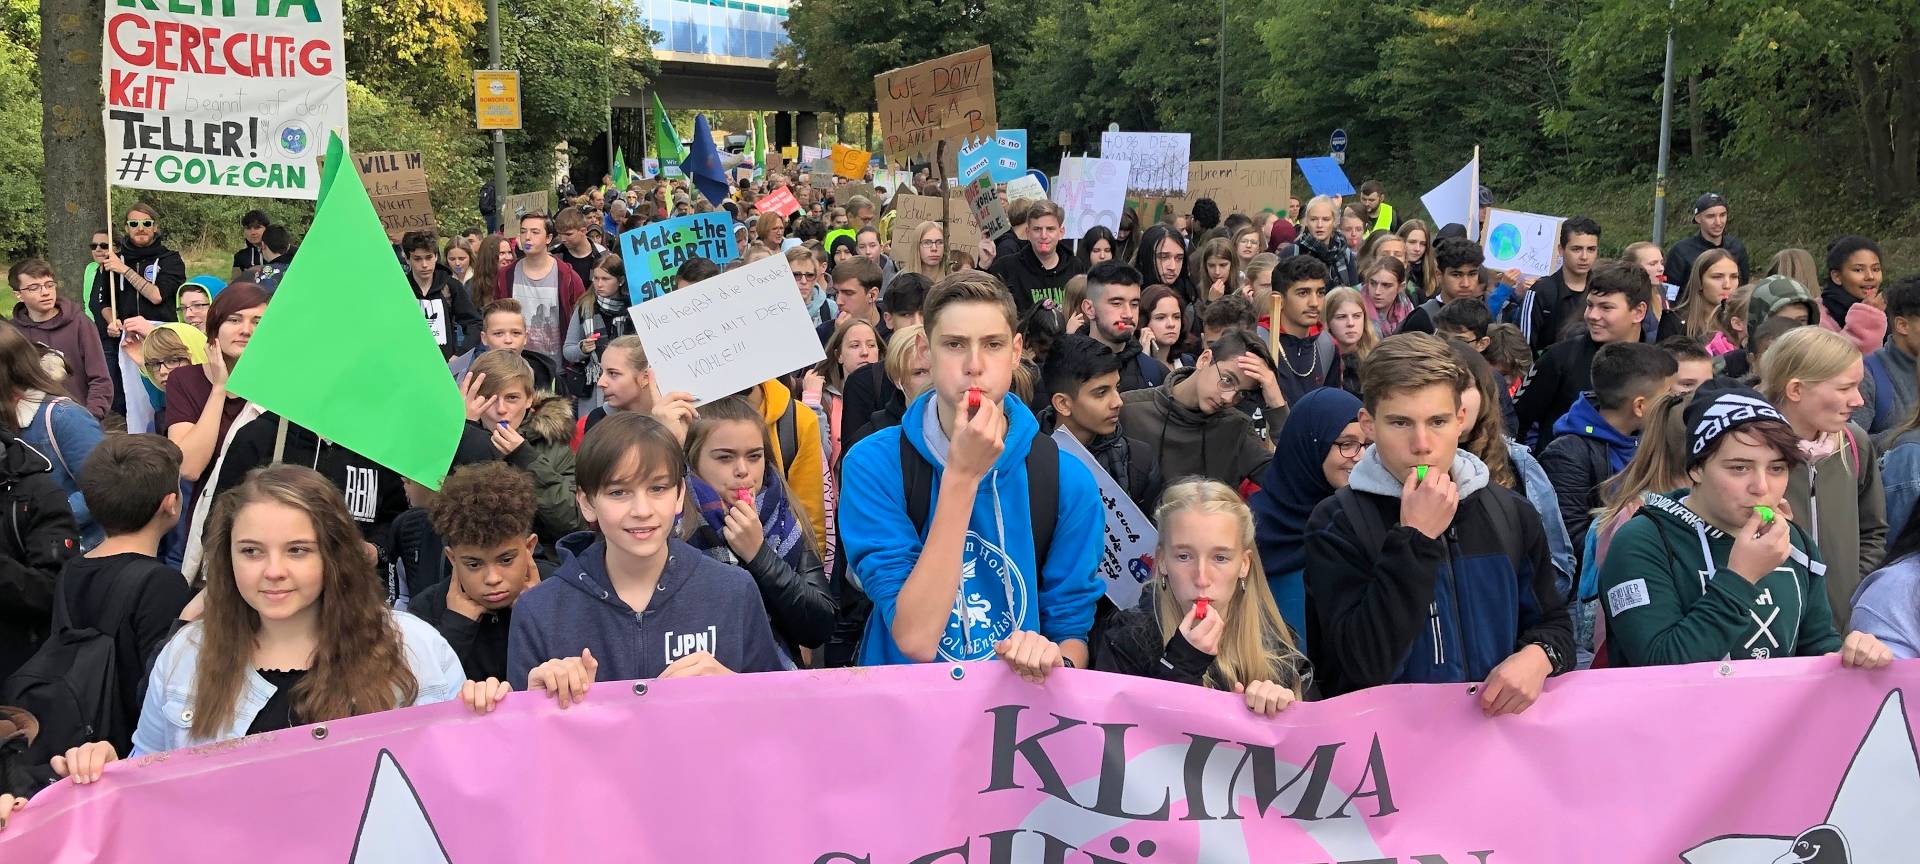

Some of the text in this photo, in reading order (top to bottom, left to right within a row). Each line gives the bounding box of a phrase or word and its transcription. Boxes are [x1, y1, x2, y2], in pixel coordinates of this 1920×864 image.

[109, 68, 175, 110] KEIT
[185, 83, 247, 120] beginnt
[295, 86, 329, 115] dem
[887, 75, 921, 100] WE
[889, 98, 960, 133] HAVE A
[964, 109, 985, 133] B
[109, 110, 259, 158] TELLER!
[1008, 141, 1020, 149] no
[1149, 135, 1179, 149] DES
[359, 152, 421, 174] WILL IM
[966, 158, 989, 177] planet
[378, 199, 413, 212] NICHT
[631, 218, 726, 255] Make the
[658, 240, 728, 271] EARTH
[641, 311, 669, 331] Wie
[719, 285, 742, 301] die
[657, 301, 791, 362] NIEDER MIT DER
[978, 704, 1400, 821] KLIMA
